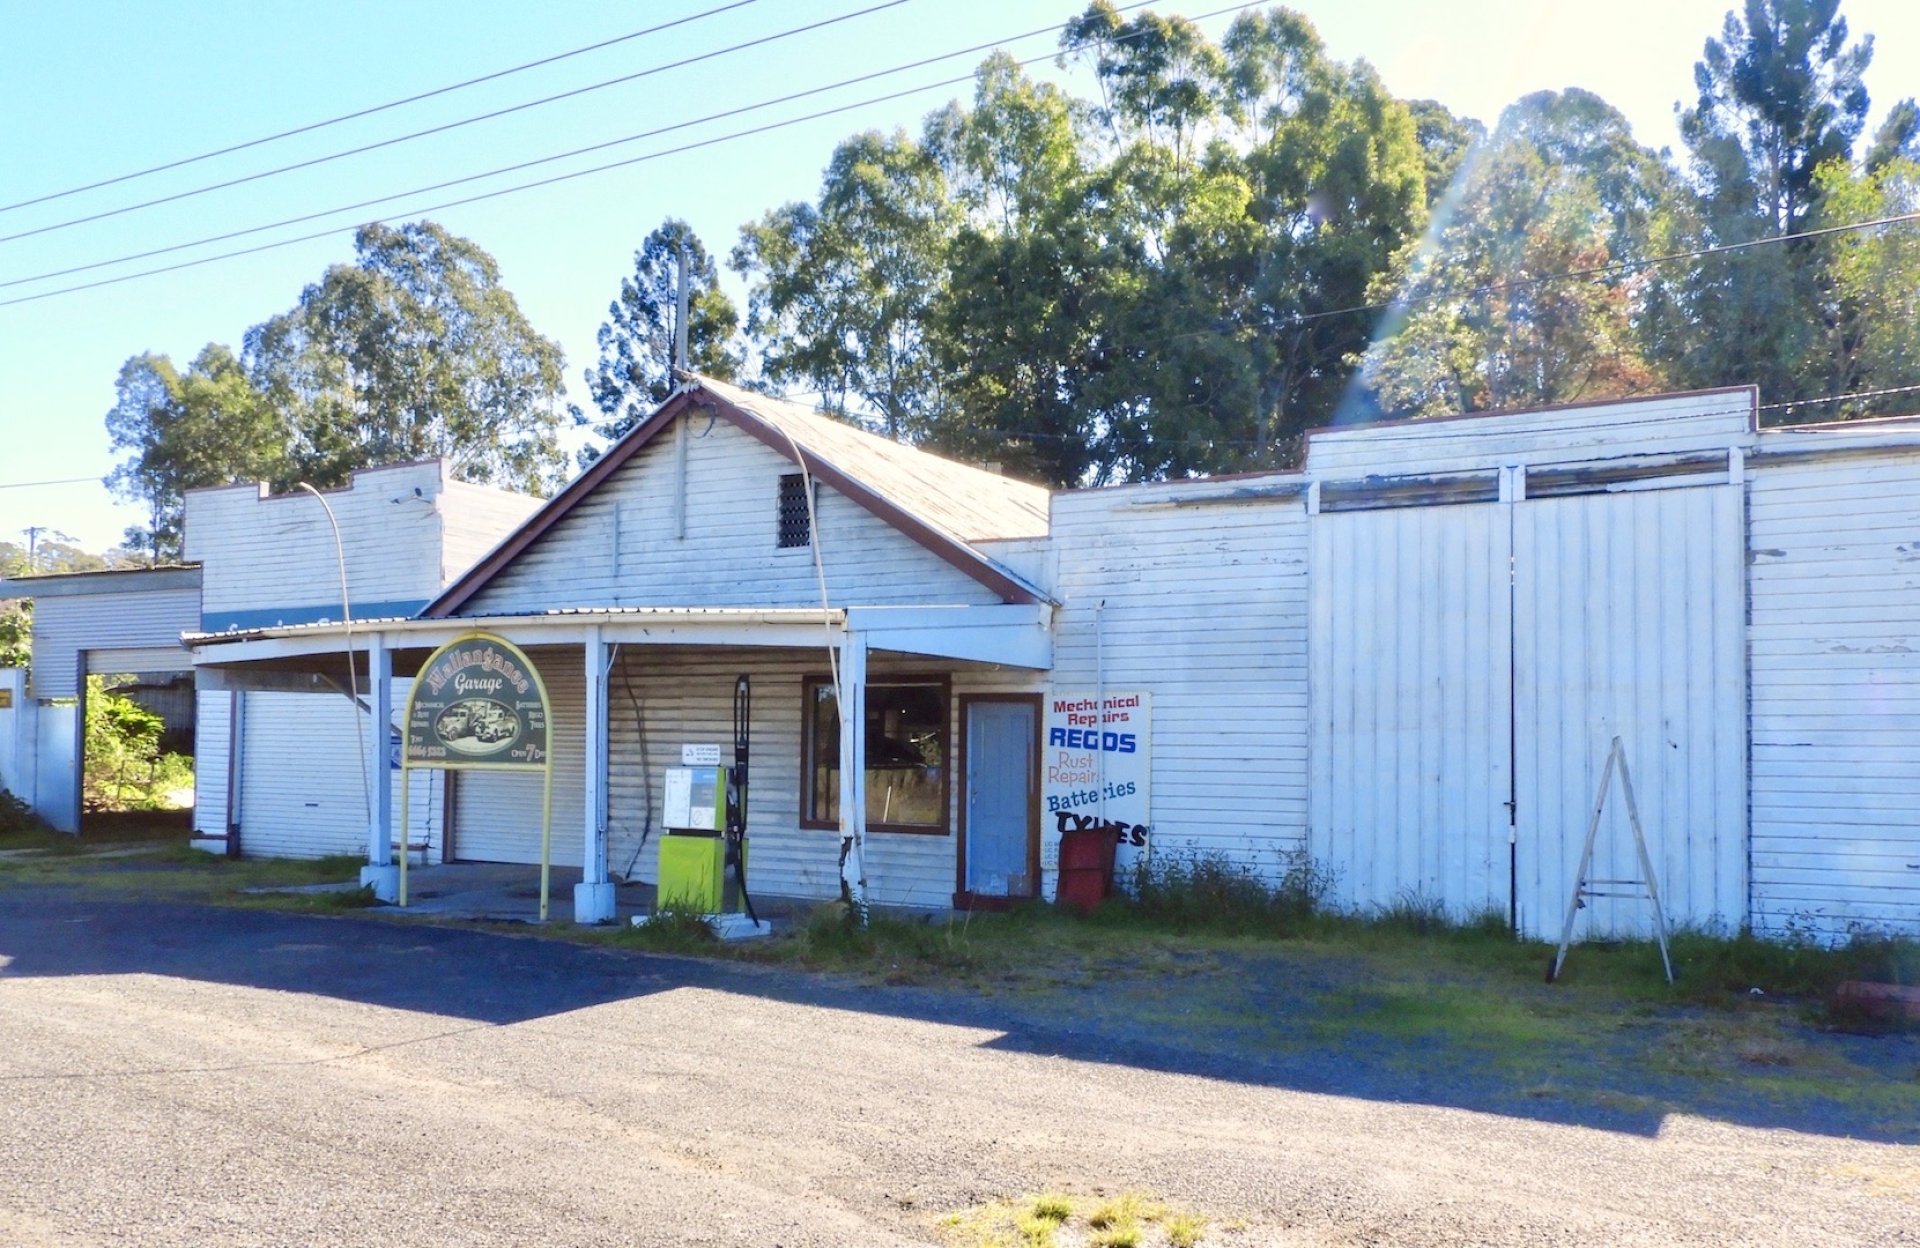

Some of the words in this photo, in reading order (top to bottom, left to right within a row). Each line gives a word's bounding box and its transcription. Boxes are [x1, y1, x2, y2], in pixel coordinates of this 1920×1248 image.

[454, 673, 503, 695] Garage
[1049, 727, 1136, 753] REGOS
[525, 743, 536, 761] 7
[1058, 751, 1094, 769] Rust
[1047, 766, 1101, 787] Repair
[1055, 811, 1147, 847] TYES
